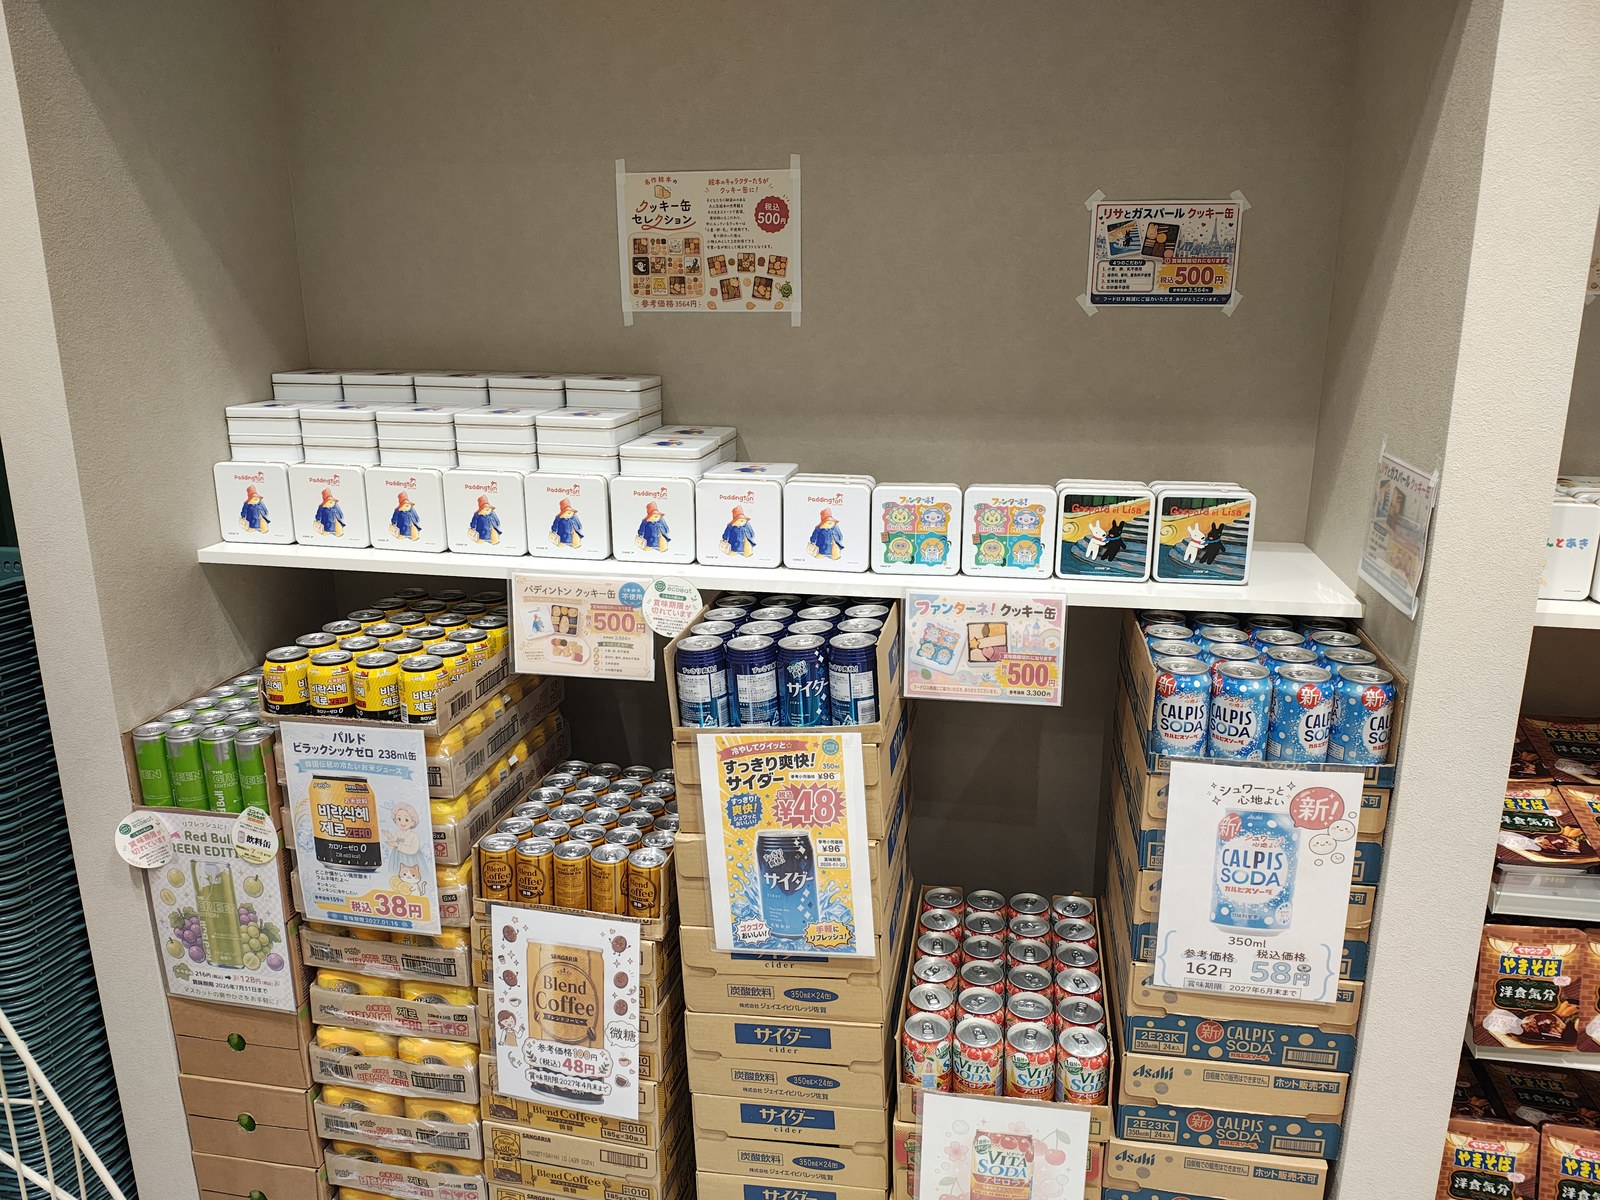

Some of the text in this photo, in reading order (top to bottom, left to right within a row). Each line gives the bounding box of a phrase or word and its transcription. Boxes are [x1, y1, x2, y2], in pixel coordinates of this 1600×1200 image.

[644, 176, 677, 185] 名作絵本の
[708, 177, 769, 186] 絵本のキャラクターたちが
[720, 186, 758, 194] クッキー缶に!
[636, 199, 691, 214] クッキー缶
[632, 214, 694, 226] セレクション
[757, 212, 786, 225] 500円
[1104, 208, 1234, 219] リサとガスパール クッキー缶
[1175, 267, 1214, 285] 500
[1214, 276, 1223, 284] 円
[642, 300, 674, 308] 参考価格
[309, 477, 340, 485] Paddington
[385, 480, 417, 489] Paddington
[464, 483, 498, 492] Paddington
[899, 496, 934, 504] ファンターネ!
[992, 498, 1028, 506] ファンターネ!
[1071, 503, 1110, 513] Gaspard
[1123, 506, 1142, 514] Lisa
[1170, 506, 1209, 516] Gaspard
[1222, 508, 1242, 517] Lisa
[524, 585, 616, 599] パディントン クッキー缶
[621, 593, 643, 601] 不使用
[653, 599, 691, 610] 賞味期限が
[915, 601, 996, 616] ファンターネ!
[652, 607, 693, 618] 切れています
[593, 613, 635, 633] 500
[636, 623, 646, 633] 円
[1008, 663, 1049, 687] 500
[1026, 689, 1051, 697] 3,300円
[1300, 687, 1322, 705] 新!
[415, 703, 434, 712] 제로
[332, 731, 366, 745] パルド
[293, 742, 417, 761] ビラックシッケゼロ 238ml缶
[730, 742, 786, 755] 冷やしてグイッと
[305, 760, 402, 774] 韓国伝統の冷たいお米ジュース
[723, 753, 815, 775] すっきり爽快!
[726, 773, 784, 791] サイダー
[818, 772, 835, 780] ¥96
[1219, 784, 1285, 797] シュワーっと
[731, 796, 757, 805] すっきり!
[778, 789, 835, 824] ¥48
[1237, 795, 1285, 806] 心地よい
[318, 804, 369, 822] 비락식혜
[732, 803, 757, 815] 爽快!
[1299, 796, 1339, 821] 新!
[733, 814, 757, 822] シュワッと
[736, 818, 757, 827] おいしい!
[320, 820, 372, 838] 제로 ZERO
[184, 831, 207, 842] Red
[247, 835, 271, 848] 飲料缶
[328, 843, 366, 852] カロリーゼロ 0
[822, 845, 841, 853] ¥96
[1222, 849, 1283, 870] CALPIS
[764, 872, 814, 892] サイダー
[1221, 867, 1281, 886] SODA
[1225, 886, 1273, 895] カルピスソーダ
[351, 894, 422, 918] 税込 38 円
[364, 917, 399, 927] 2027.01.16
[740, 924, 764, 932] ゴクゴク
[741, 929, 767, 940] おいしい!
[816, 925, 840, 934] 手軽に
[810, 933, 847, 941] リフレッシュ!
[1228, 936, 1266, 948] 350ml
[551, 954, 578, 962] SANGARIA
[1184, 948, 1307, 962] 参考価格 税込価格
[765, 961, 795, 969] cider
[1503, 958, 1558, 976] やきそば
[240, 975, 261, 984] 128円
[1186, 961, 1311, 987] 162円 58円
[215, 983, 268, 994] 2026年7月31日まで
[543, 975, 587, 995] Blend
[730, 986, 772, 997] 炭酸飲料
[1187, 979, 1297, 997] 賞味期限 2027年6月末まで
[1500, 985, 1556, 1001] 洋食気分
[536, 992, 595, 1016] Coffee
[609, 1026, 636, 1042] 微糖
[754, 1027, 811, 1045] サイダー
[1141, 1031, 1180, 1042] 2E23K
[1226, 1026, 1275, 1043] CALPIS
[537, 1043, 598, 1061] 参考価格100円
[1226, 1040, 1273, 1054] SODA
[539, 1056, 595, 1075] (税込) 48円
[959, 1061, 991, 1073] VITA
[734, 1071, 775, 1083] 炭酸飲料
[1132, 1064, 1174, 1081] Asahi
[529, 1071, 608, 1092] 賞味期限2027年4月末まで
[1205, 1072, 1339, 1092] 自販機での販売はできません。 ホット販売不可
[532, 1105, 598, 1124] Blend Coffee
[628, 1126, 645, 1134] 010
[773, 1126, 803, 1134] cider
[1132, 1120, 1170, 1130] 2E23K
[1216, 1116, 1264, 1132] CALPIS
[522, 1133, 551, 1143] SANGARIA
[1215, 1129, 1262, 1142] SODA
[740, 1152, 781, 1164] 炭酸飲料
[988, 1151, 1028, 1167] VITA
[1115, 1149, 1155, 1166] Asahi
[1457, 1151, 1513, 1172] やきそば
[536, 1169, 601, 1186] Blend Coffee
[983, 1176, 1029, 1187] アセロラ
[1254, 1168, 1318, 1184] ホット販売不可
[1454, 1177, 1511, 1196] 洋食気分
